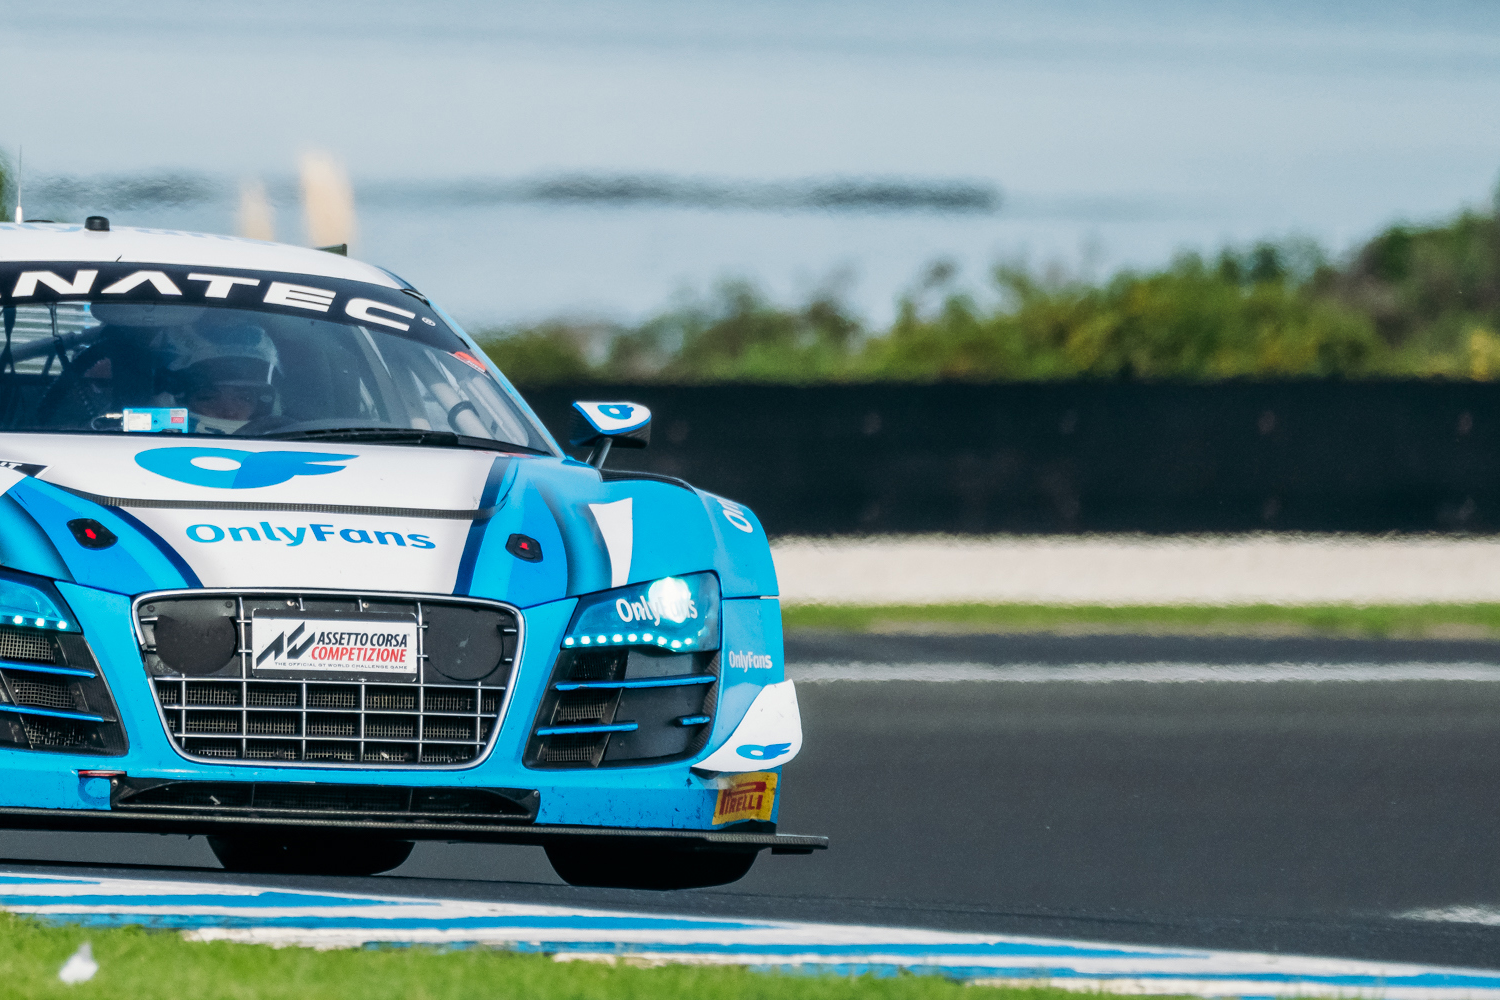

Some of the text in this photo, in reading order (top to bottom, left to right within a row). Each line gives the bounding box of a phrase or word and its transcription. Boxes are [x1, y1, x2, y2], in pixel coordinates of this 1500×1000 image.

[185, 521, 437, 550] OnlyFans
[615, 594, 699, 627] Onlyns
[316, 631, 408, 648] ASSETTO CORSA
[311, 646, 407, 664] COMPETIZIONE
[728, 650, 773, 673] OnlyFans
[719, 781, 767, 815] PIRELLI
